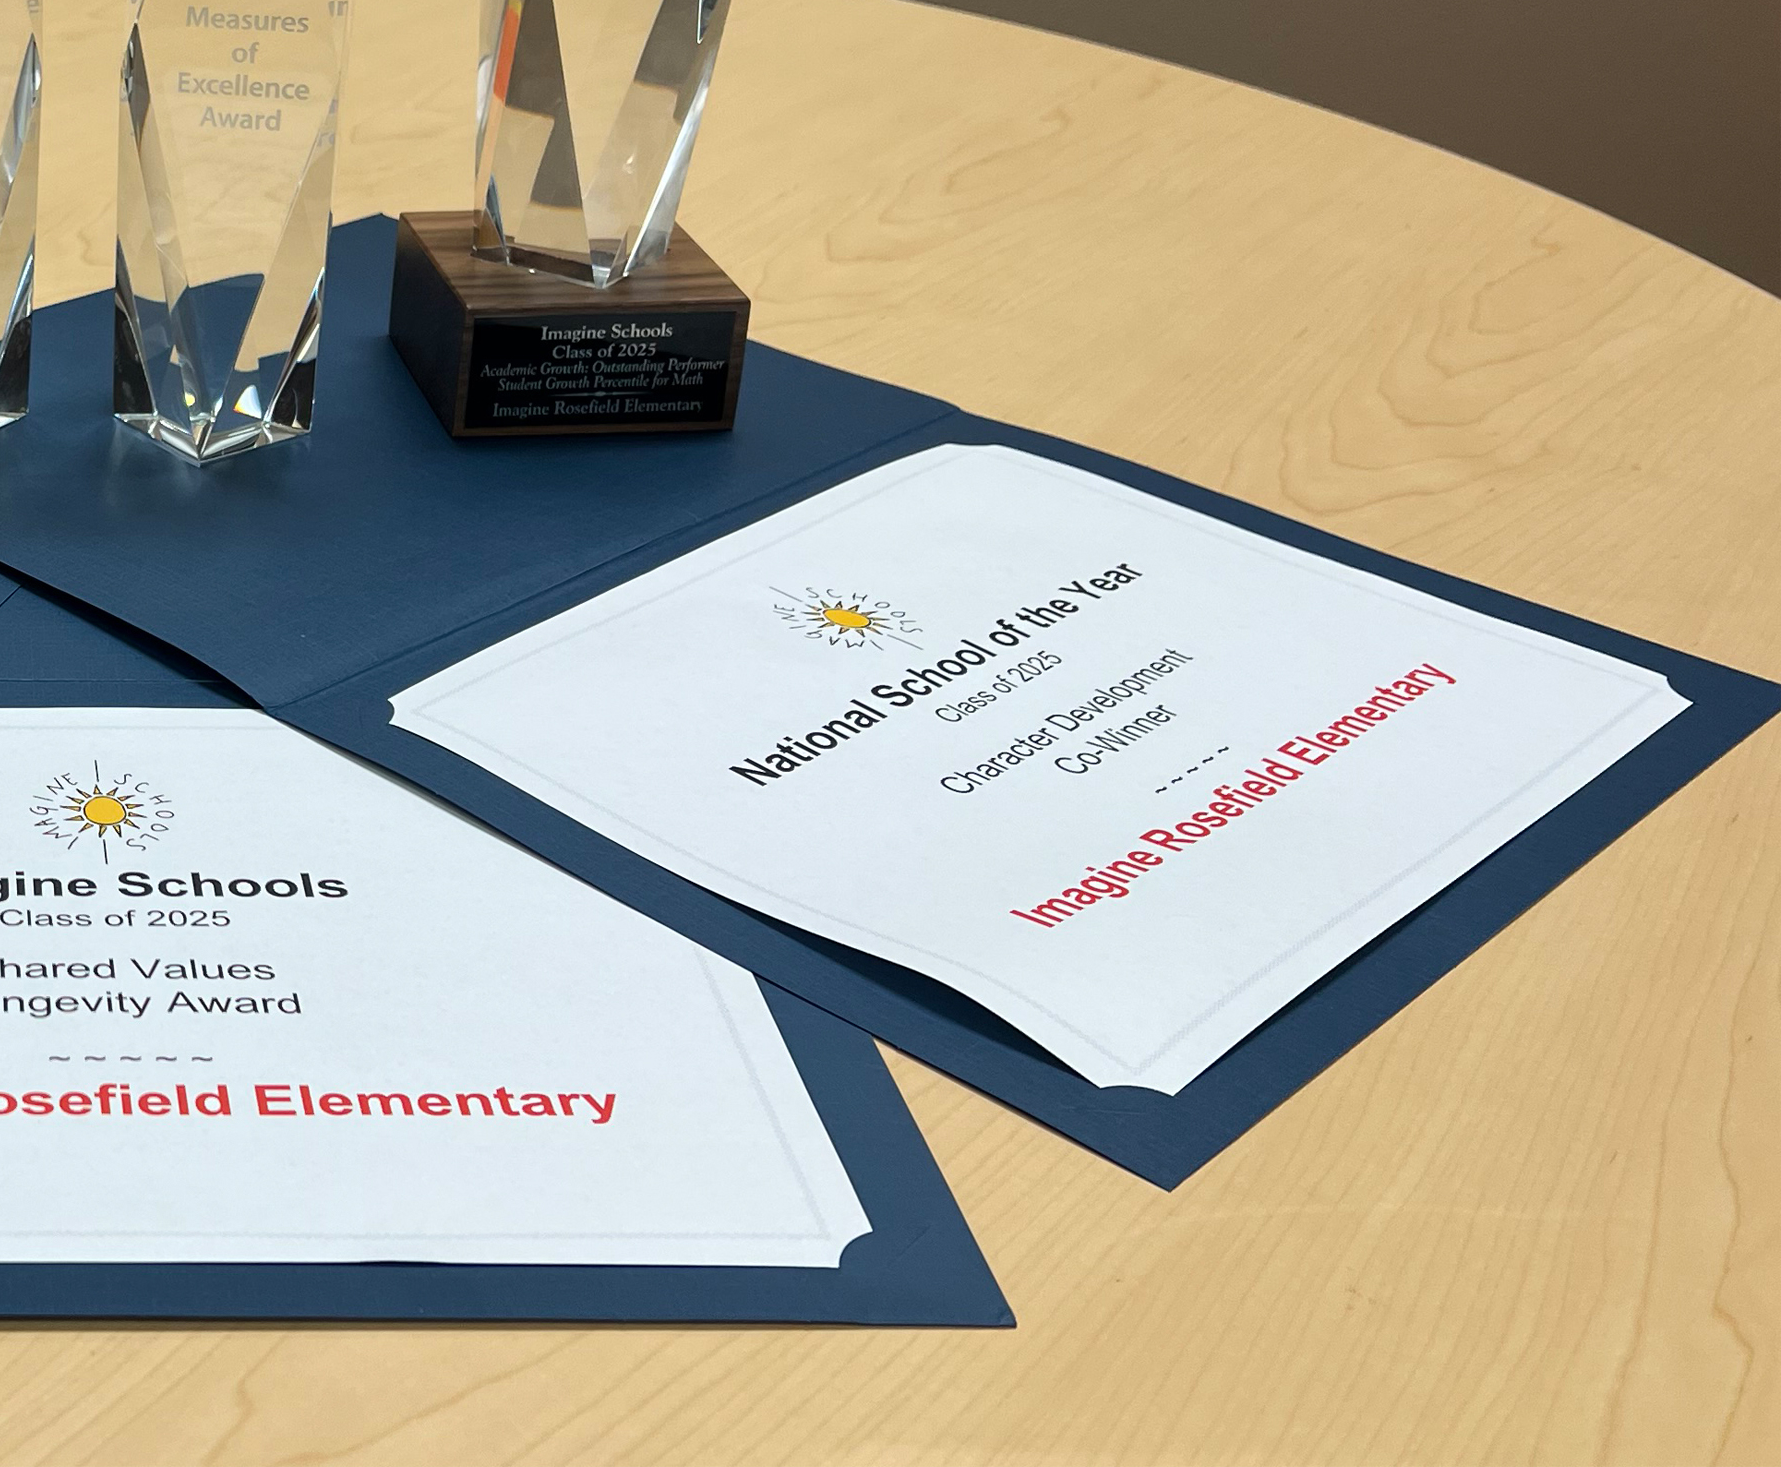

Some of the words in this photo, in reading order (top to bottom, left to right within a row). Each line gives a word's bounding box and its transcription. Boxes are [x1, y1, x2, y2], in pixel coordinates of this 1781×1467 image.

[185, 5, 310, 34] Measures
[231, 41, 261, 65] of
[177, 71, 311, 101] Excellence
[200, 106, 282, 132] Award
[540, 326, 606, 343] Imagine
[610, 322, 674, 339] Schools
[552, 345, 593, 360] Class
[597, 343, 615, 358] of
[617, 342, 657, 358] 2025
[480, 363, 537, 378] Academic
[539, 360, 589, 376] Growth:
[592, 358, 665, 376] Outstanding
[667, 357, 725, 375] Performer
[497, 377, 542, 392] Student
[545, 375, 590, 390] Growth
[593, 373, 648, 389] Percentile
[651, 372, 670, 390] for
[671, 372, 704, 386] Math
[493, 402, 550, 419] Imagine
[553, 399, 620, 416] Rosefield
[624, 398, 704, 414] Elementary
[729, 699, 889, 787] National
[870, 639, 997, 709] School
[988, 618, 1020, 648] of
[1015, 599, 1080, 630] the
[1058, 563, 1143, 600] Year
[934, 688, 998, 723] Class
[991, 675, 1018, 695] of
[1011, 650, 1063, 683] 2025
[940, 727, 1060, 795] Character
[1045, 648, 1194, 733] Development
[1053, 703, 1177, 775] Co-Winner
[1009, 845, 1164, 928] Imagine
[1139, 757, 1304, 852] Rosefield
[1276, 662, 1457, 766] Elementary
[117, 871, 349, 899] Schools
[0, 909, 93, 927] Class
[104, 909, 136, 927] of
[147, 909, 231, 927] 2025
[130, 958, 276, 980] Values
[167, 992, 302, 1015] Award
[254, 1084, 617, 1125] Elementary
